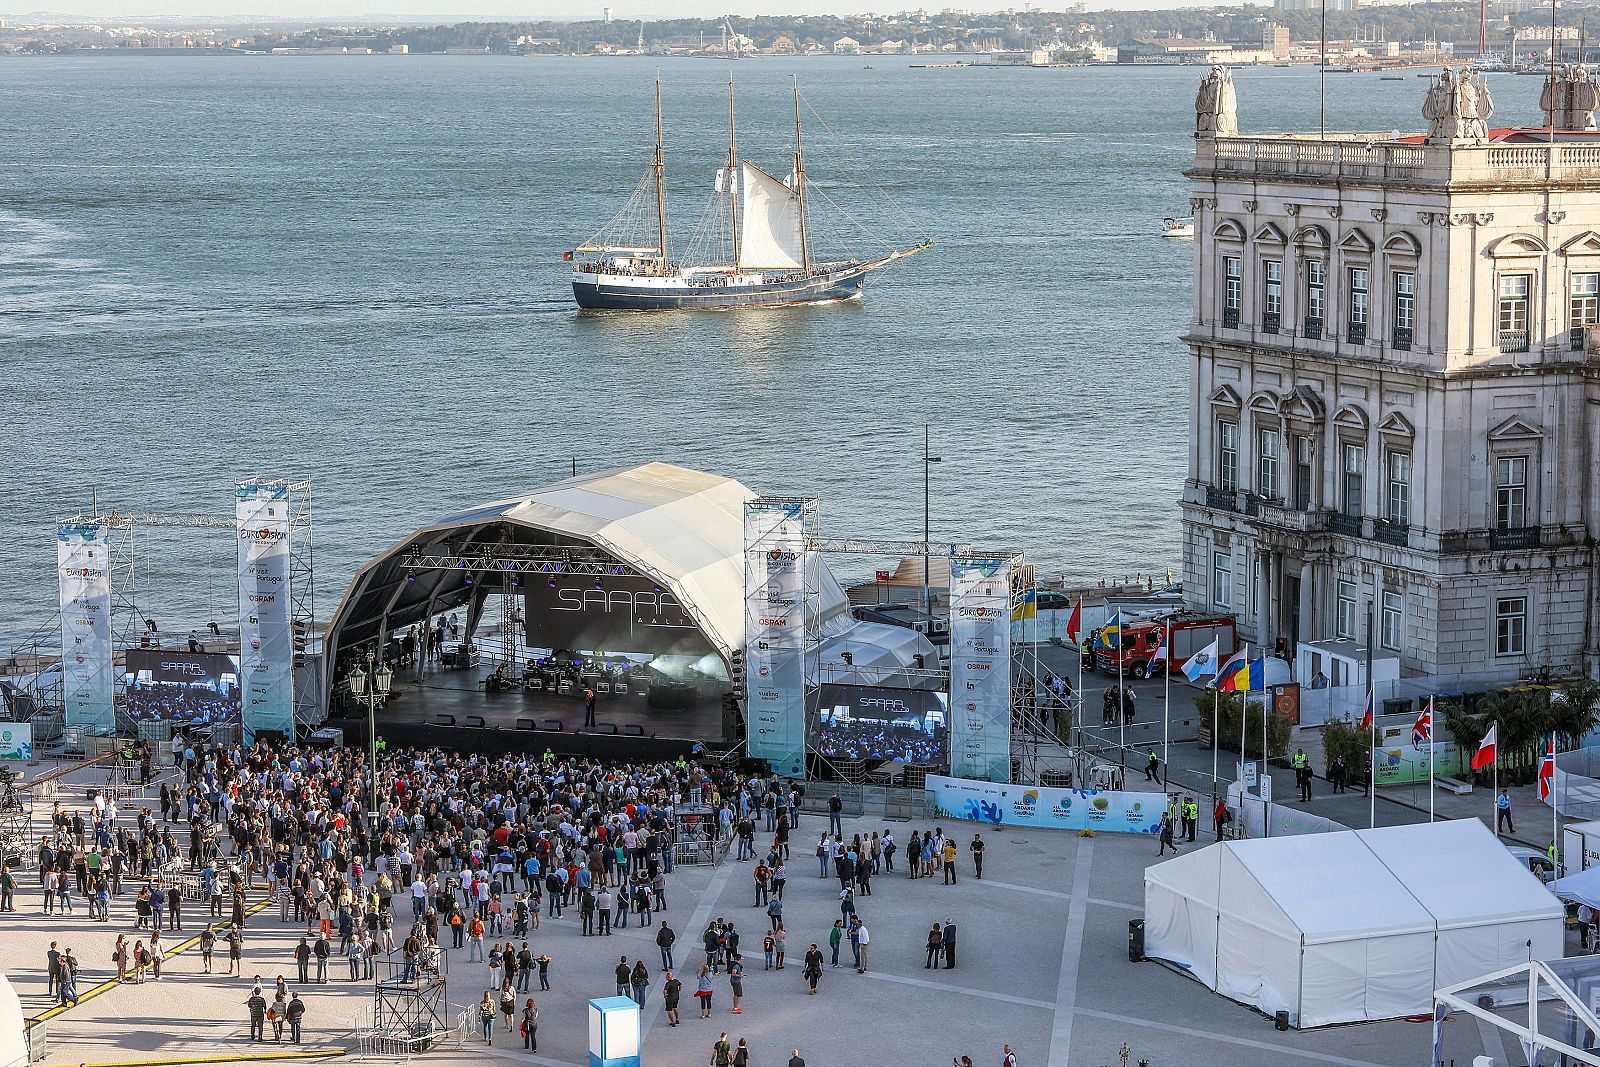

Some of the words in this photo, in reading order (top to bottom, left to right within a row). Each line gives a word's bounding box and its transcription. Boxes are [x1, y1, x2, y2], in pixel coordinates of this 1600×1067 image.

[256, 574, 284, 586] Portugal
[249, 595, 275, 604] OSRAM
[767, 597, 796, 608] Portugal
[759, 618, 787, 627] OSRAM
[973, 646, 999, 656] Portugal
